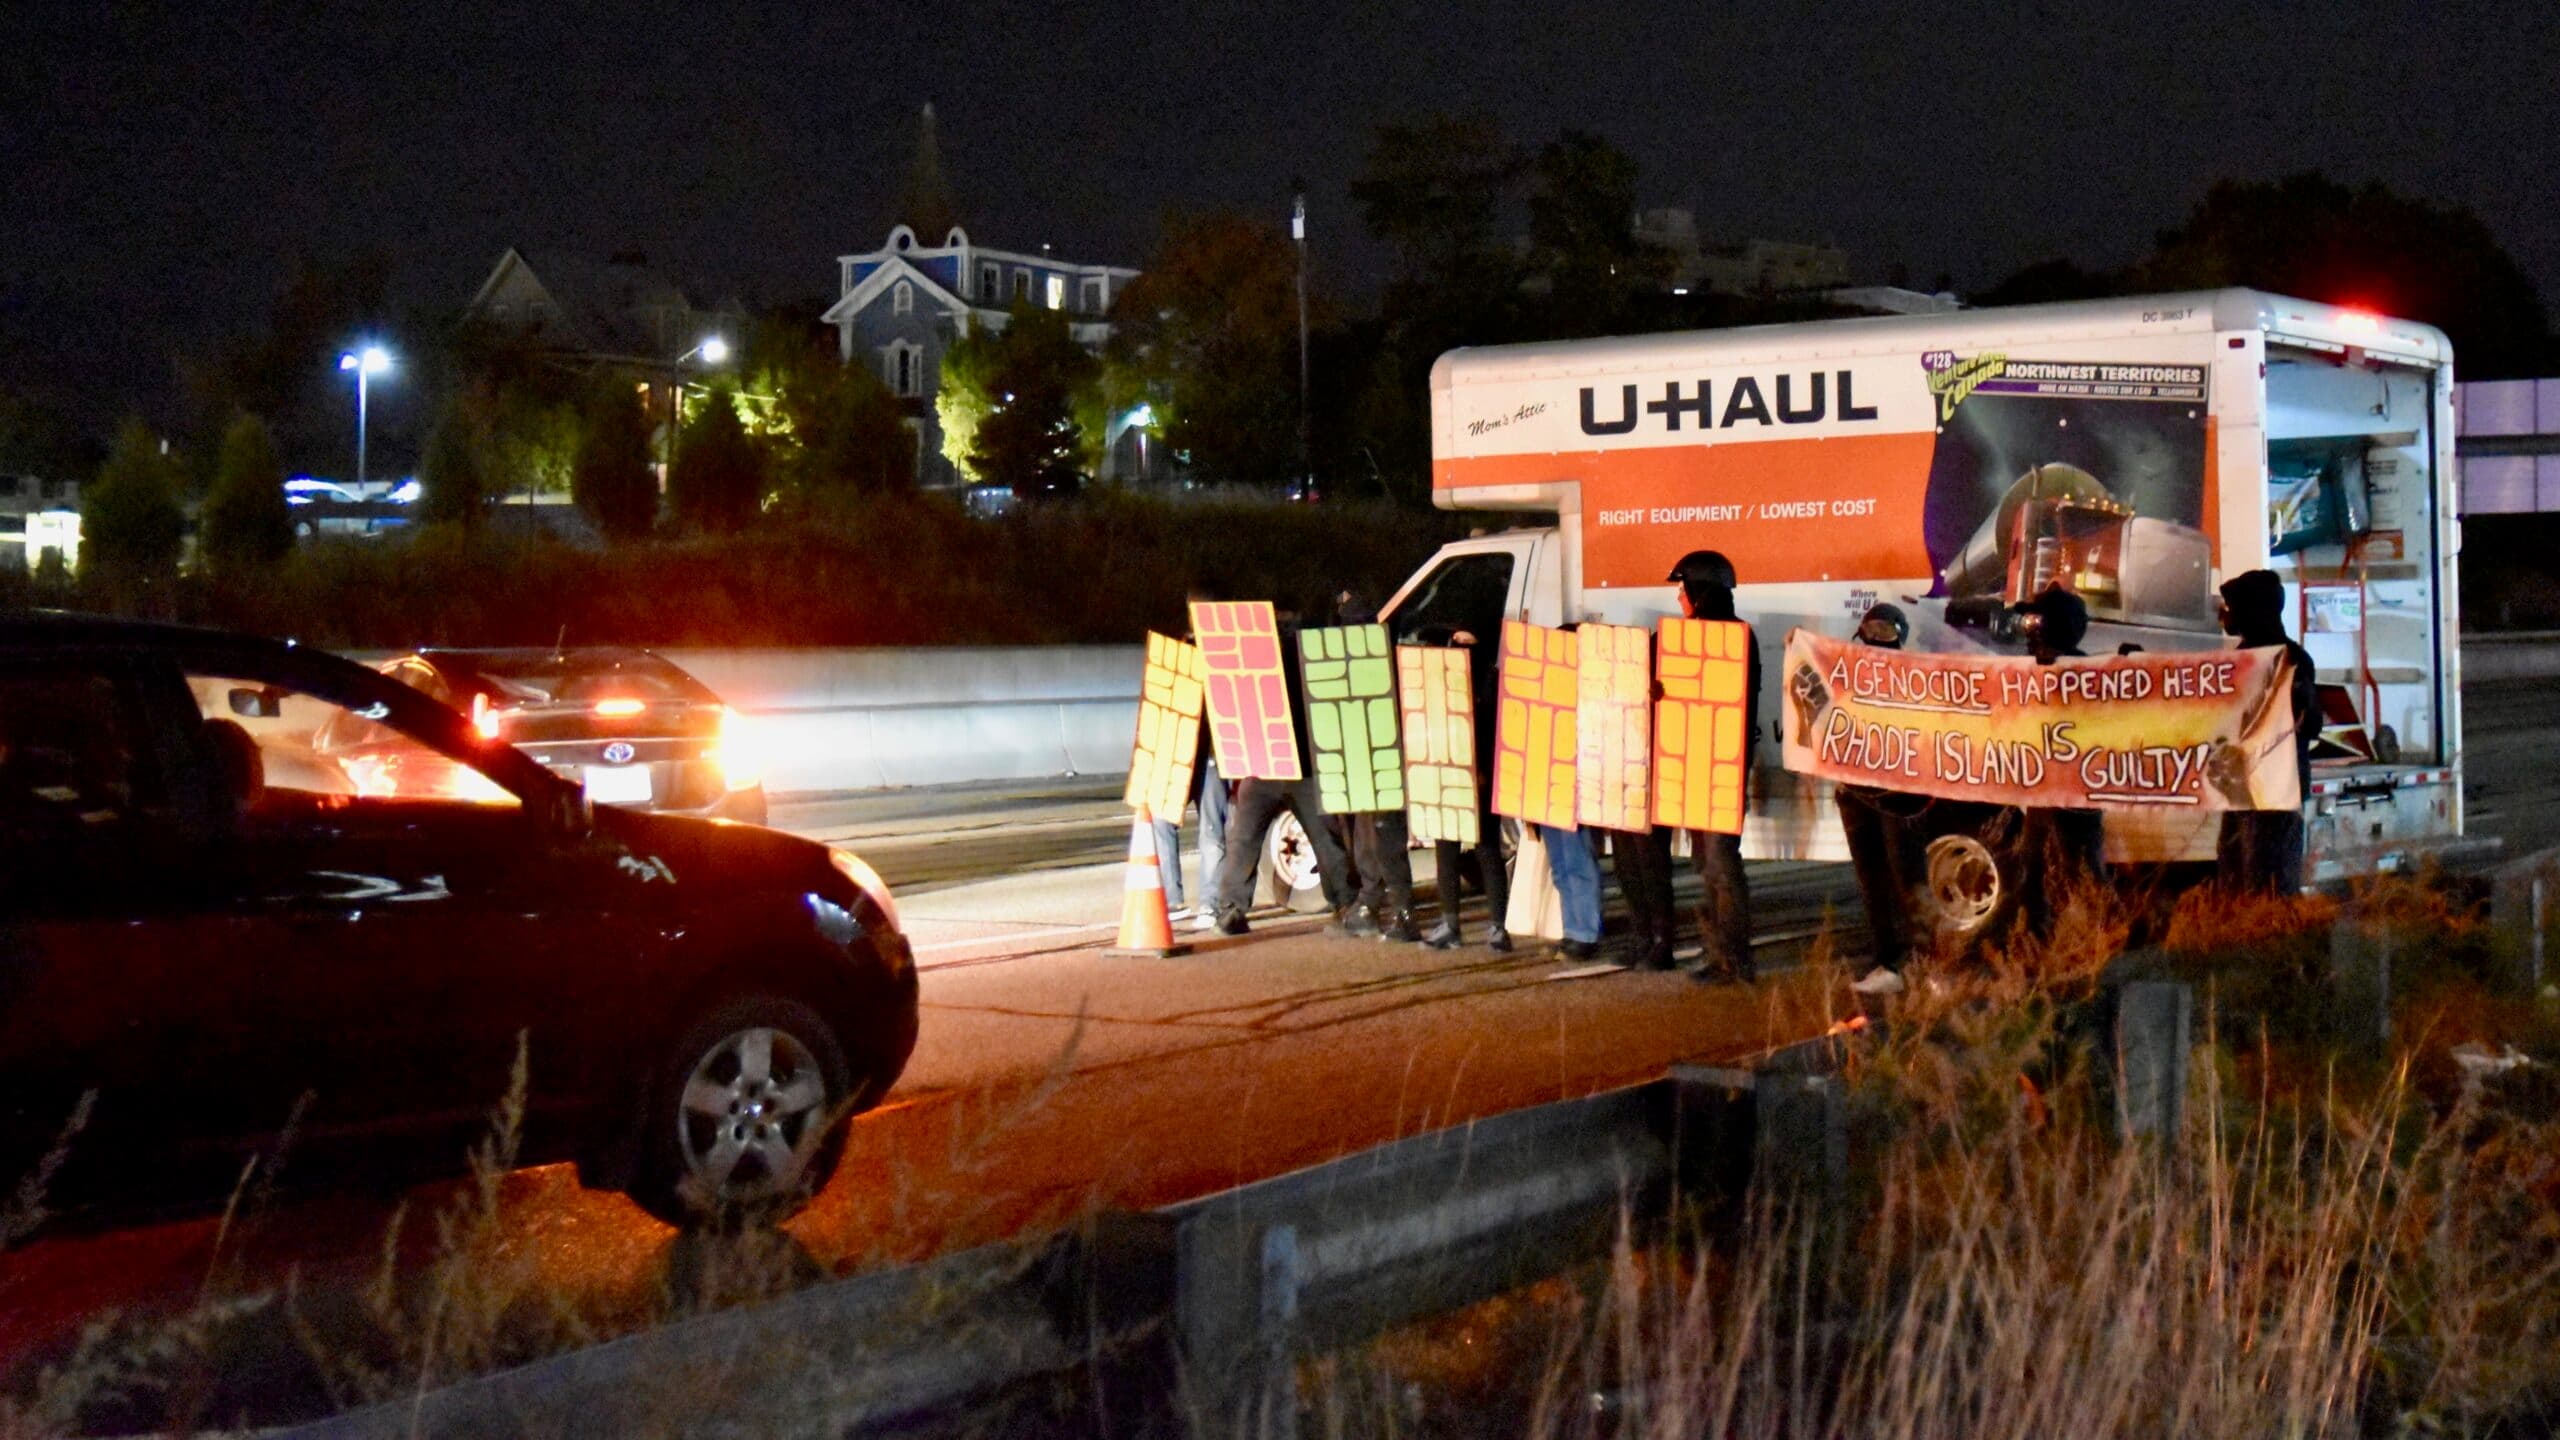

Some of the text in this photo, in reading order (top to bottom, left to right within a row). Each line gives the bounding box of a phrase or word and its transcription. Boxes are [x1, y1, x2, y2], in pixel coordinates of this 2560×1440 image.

[2142, 311, 2158, 323] DC
[1925, 352, 1952, 369] #128
[2005, 363, 2201, 383] NORTHWEST TERRITORIES
[1579, 370, 1878, 435] U-HAUL
[1942, 360, 2005, 421] Canada
[1467, 403, 1546, 437] Mom's Attic
[1599, 508, 1645, 526] RIGHT
[1650, 504, 1743, 524] EQUIPMENT
[1760, 501, 1827, 520] LOWEST
[1831, 498, 1877, 517] COST
[1850, 588, 1878, 599] Where
[1828, 655, 2236, 709] A GENOCIDE HAPPENED HERE
[1821, 706, 1921, 777] RHODE
[1935, 731, 2045, 788] ISLAND
[2041, 721, 2079, 763] IS
[2080, 743, 2210, 793] GUILTY!
